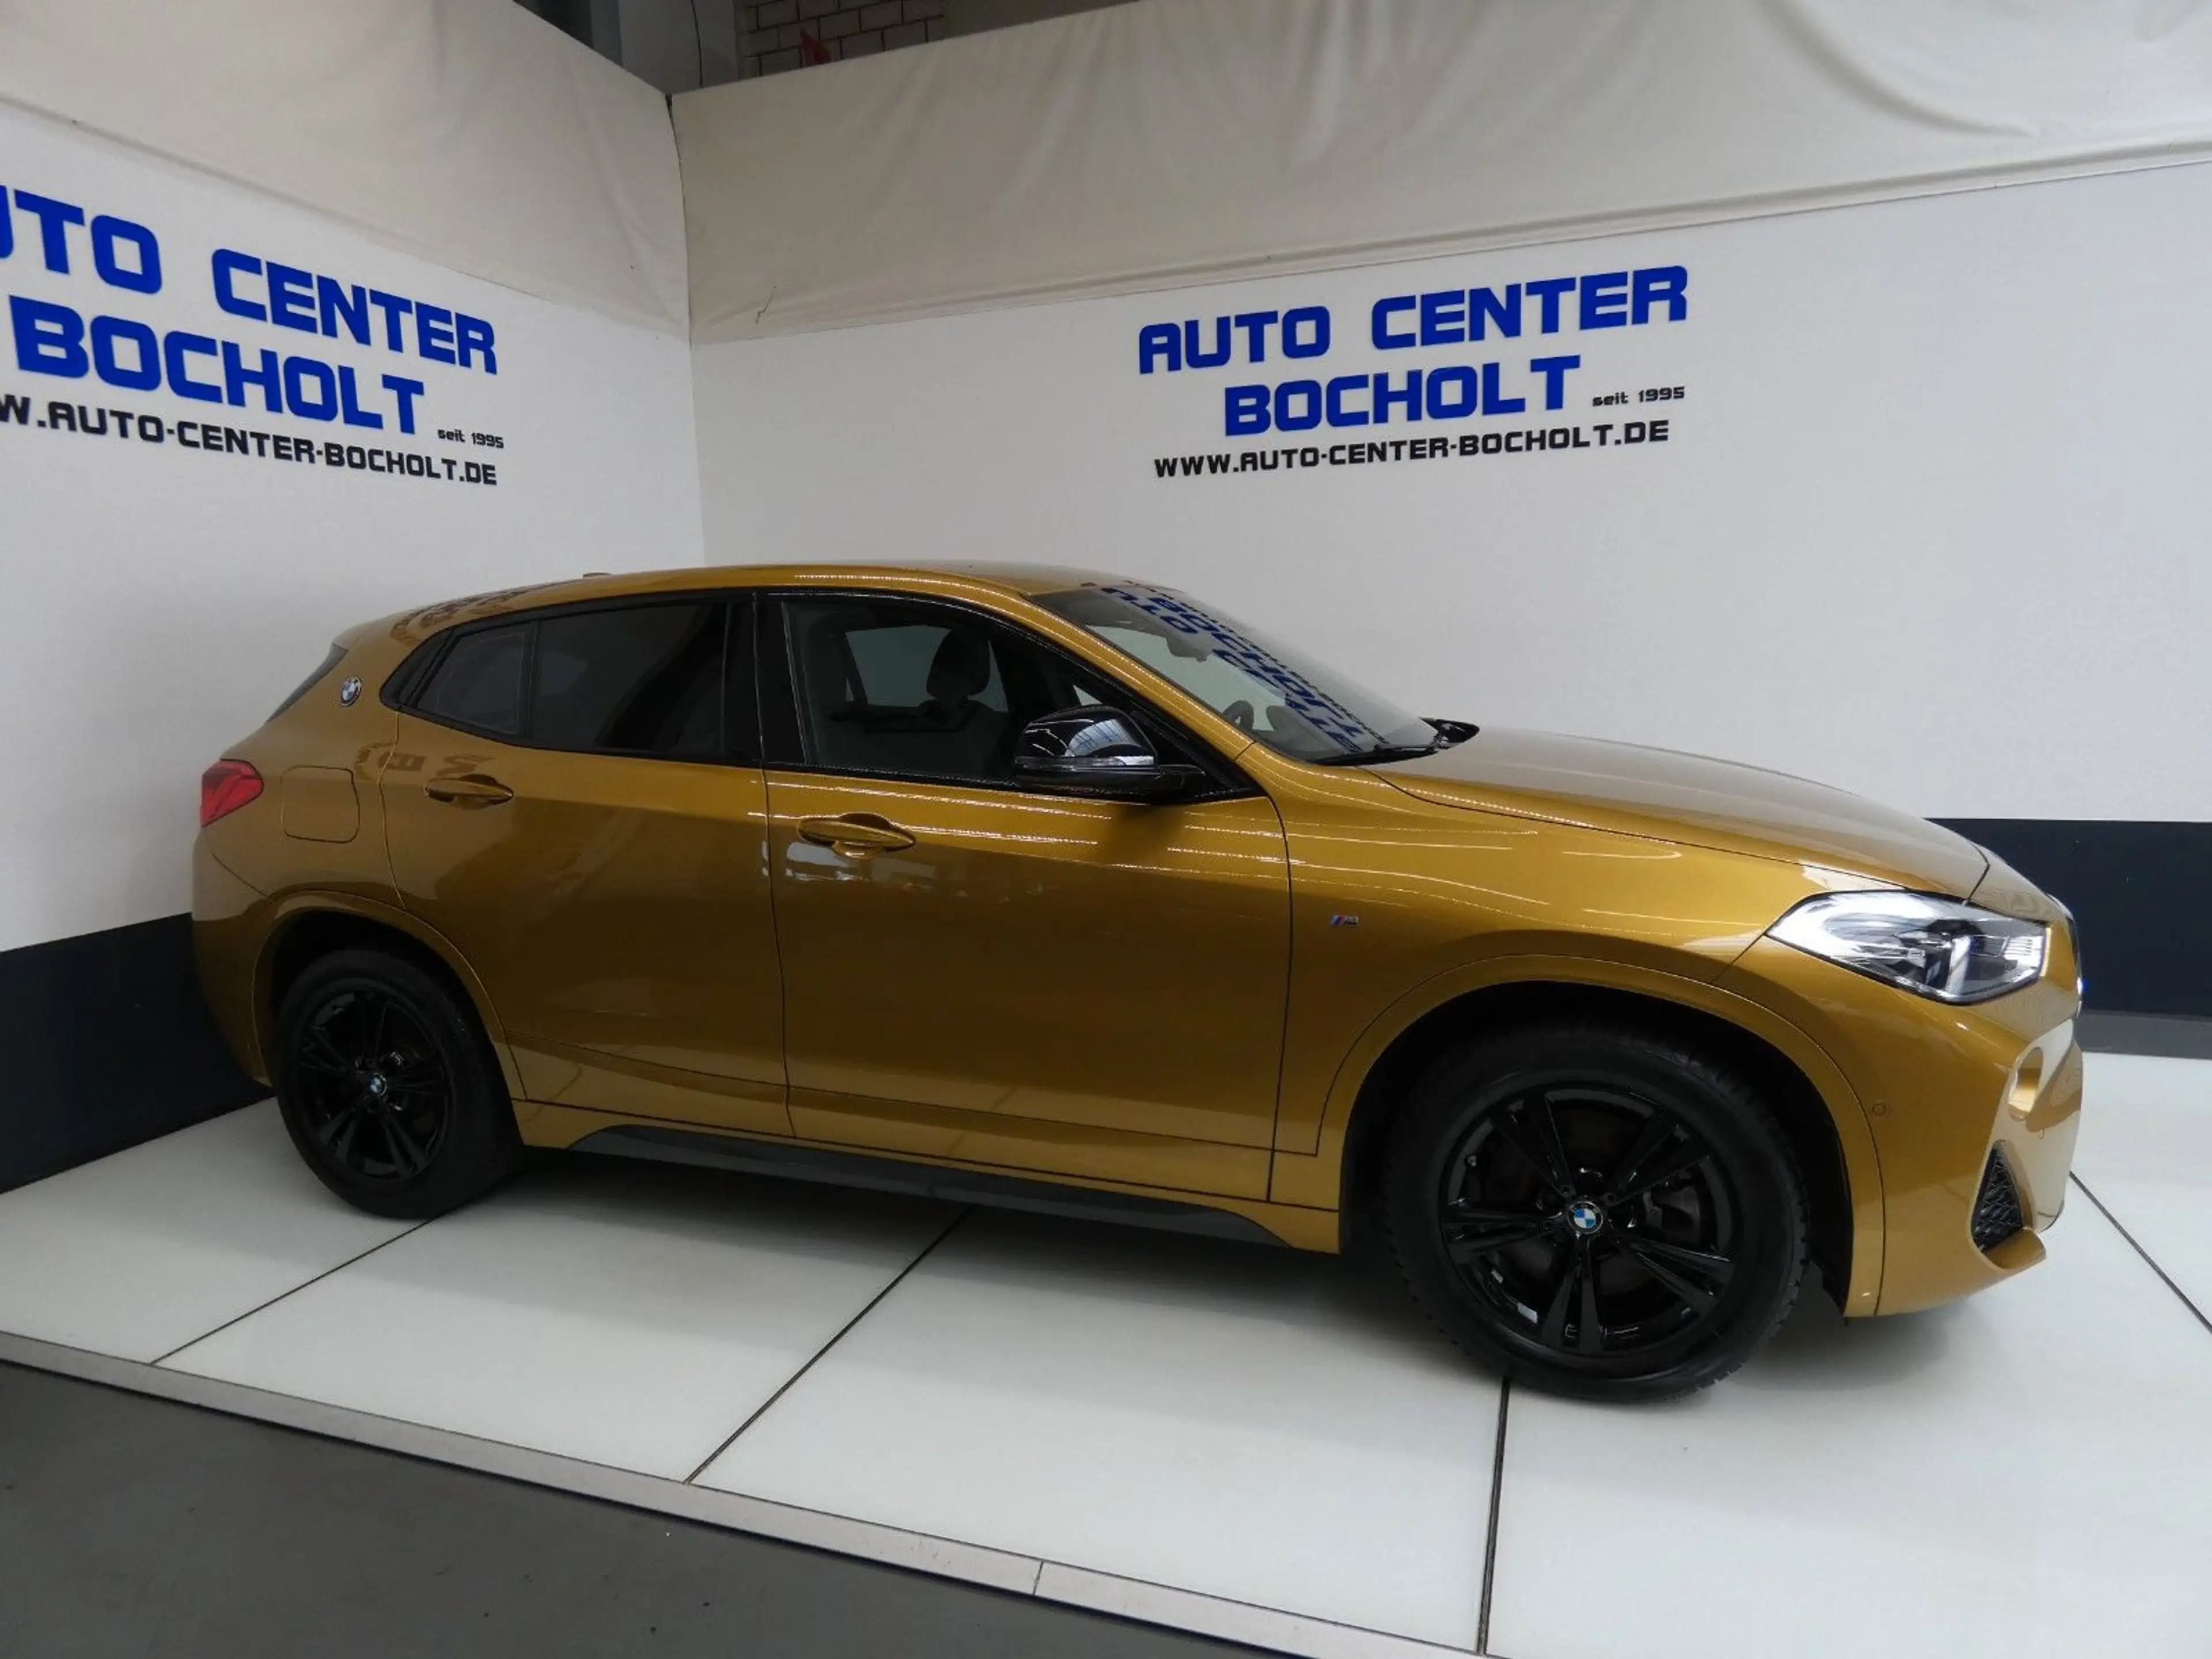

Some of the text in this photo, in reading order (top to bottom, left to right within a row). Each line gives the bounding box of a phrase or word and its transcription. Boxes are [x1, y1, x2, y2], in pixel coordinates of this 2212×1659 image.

[211, 248, 497, 375] CENTER
[1139, 265, 1688, 374] AUTO CENTER
[9, 296, 425, 435] BOCHOLT
[1225, 354, 1581, 437] BOCHOLT
[1592, 386, 1685, 407] seit 1995
[437, 429, 504, 449] seit 1995
[1154, 419, 1669, 478] WWW.AUTO-CENTER-BOCHOLT.DE
